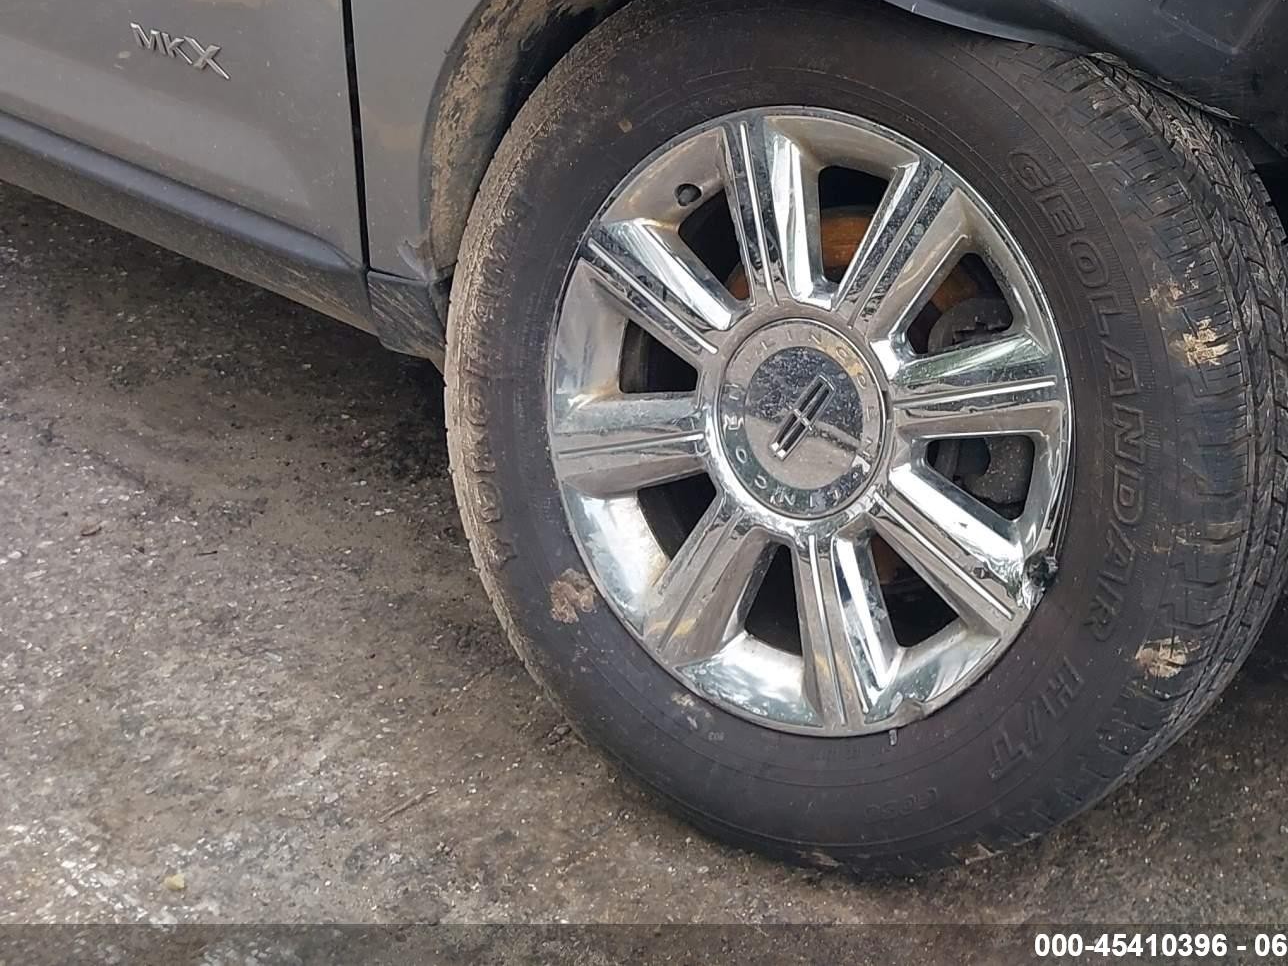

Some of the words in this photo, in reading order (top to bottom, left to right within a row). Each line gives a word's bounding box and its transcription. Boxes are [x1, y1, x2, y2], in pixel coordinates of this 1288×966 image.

[130, 22, 230, 80] MKX
[756, 329, 874, 460] LINCOLN
[1007, 148, 1146, 643] GEOLANDAR
